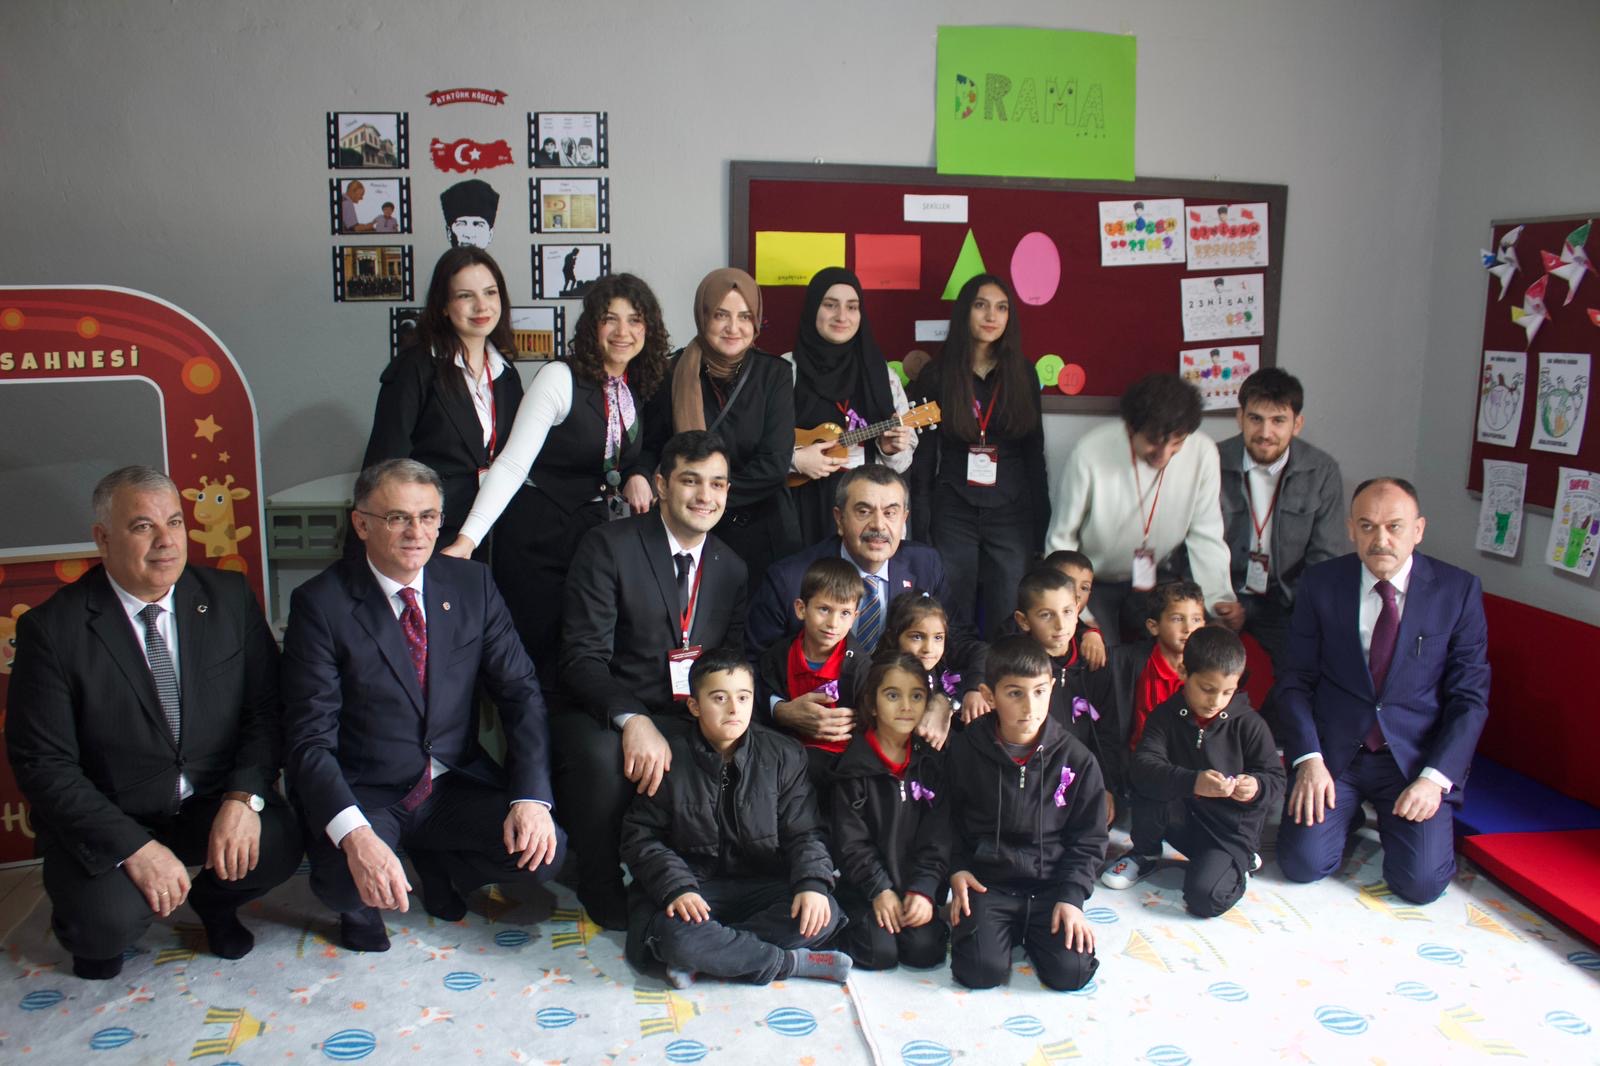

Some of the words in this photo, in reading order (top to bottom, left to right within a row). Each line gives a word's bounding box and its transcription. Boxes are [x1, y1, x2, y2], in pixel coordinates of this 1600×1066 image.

[954, 72, 1105, 129] DRAMA
[0, 345, 139, 371] SAHNESİ
[1043, 363, 1055, 382] 9
